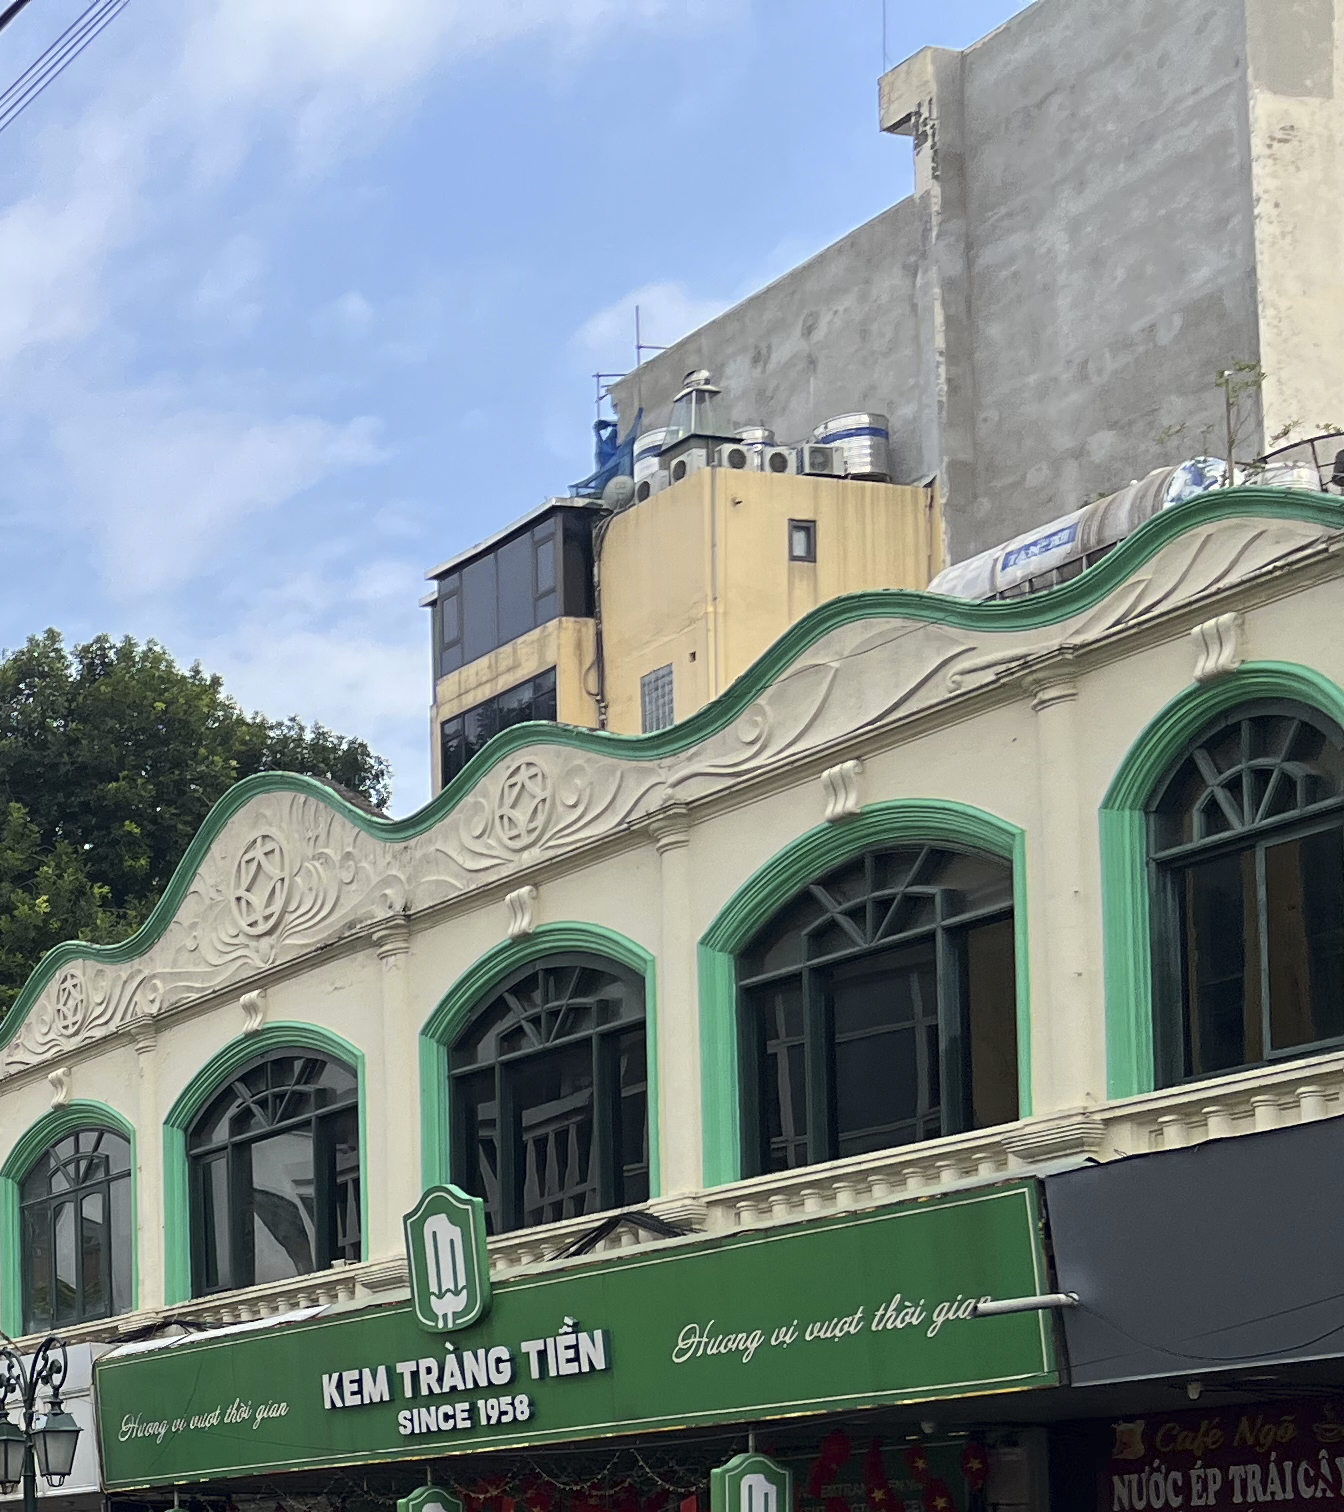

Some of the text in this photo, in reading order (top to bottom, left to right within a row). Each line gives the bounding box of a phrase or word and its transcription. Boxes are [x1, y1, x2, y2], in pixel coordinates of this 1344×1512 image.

[770, 1319, 799, 1349] vị
[871, 1293, 927, 1332] thời
[321, 1315, 607, 1410] KEM TRÀNG TIỀN
[224, 1396, 253, 1424] thời
[252, 1399, 289, 1430] gian
[398, 1393, 531, 1435] SINCE 1958
[1112, 1458, 1183, 1512] NƯỚC
[1189, 1459, 1223, 1507] ÉP
[1228, 1451, 1294, 1504] TRÁI
